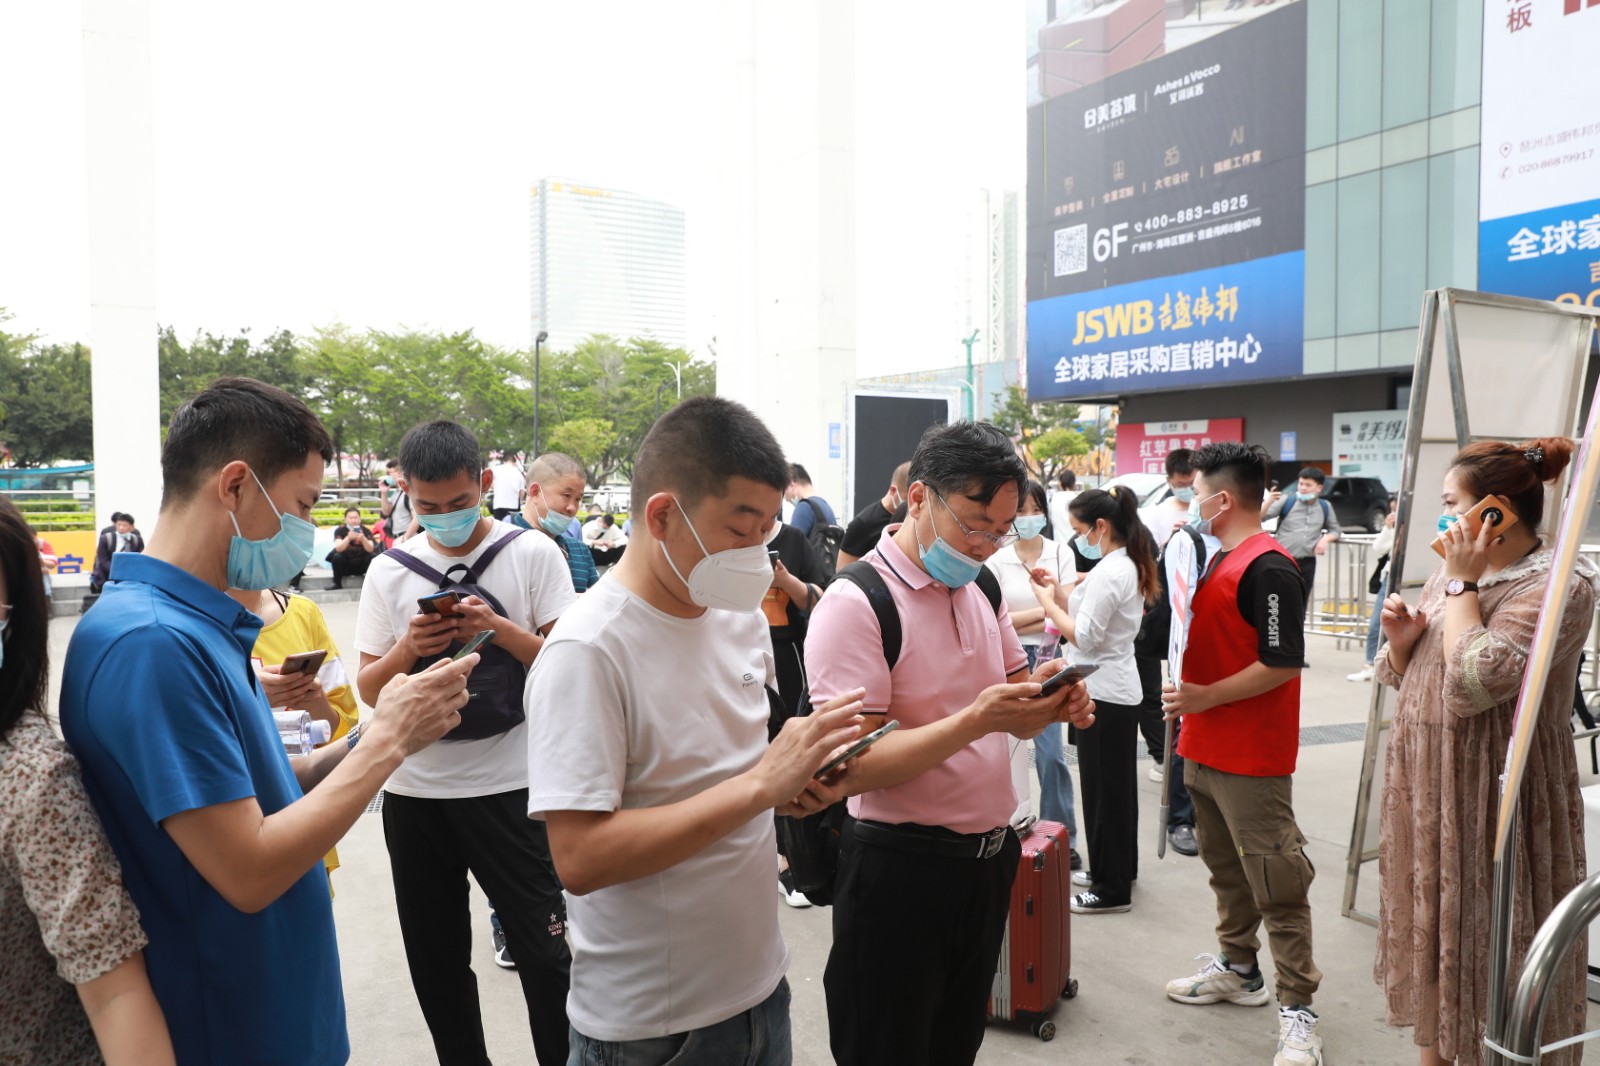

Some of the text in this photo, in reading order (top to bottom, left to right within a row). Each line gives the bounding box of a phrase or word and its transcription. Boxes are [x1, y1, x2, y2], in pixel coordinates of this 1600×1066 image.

[1506, 0, 1532, 33] 板
[1518, 149, 1595, 174] 020-86879917
[1144, 194, 1249, 231] 400-883-8925
[1092, 221, 1129, 262] 6F
[1072, 299, 1155, 346] JSWB
[1158, 283, 1239, 331] 吉盛伟邦
[1054, 333, 1263, 384] 全球家居采购直销中心
[1268, 593, 1279, 648] OPPOSITE
